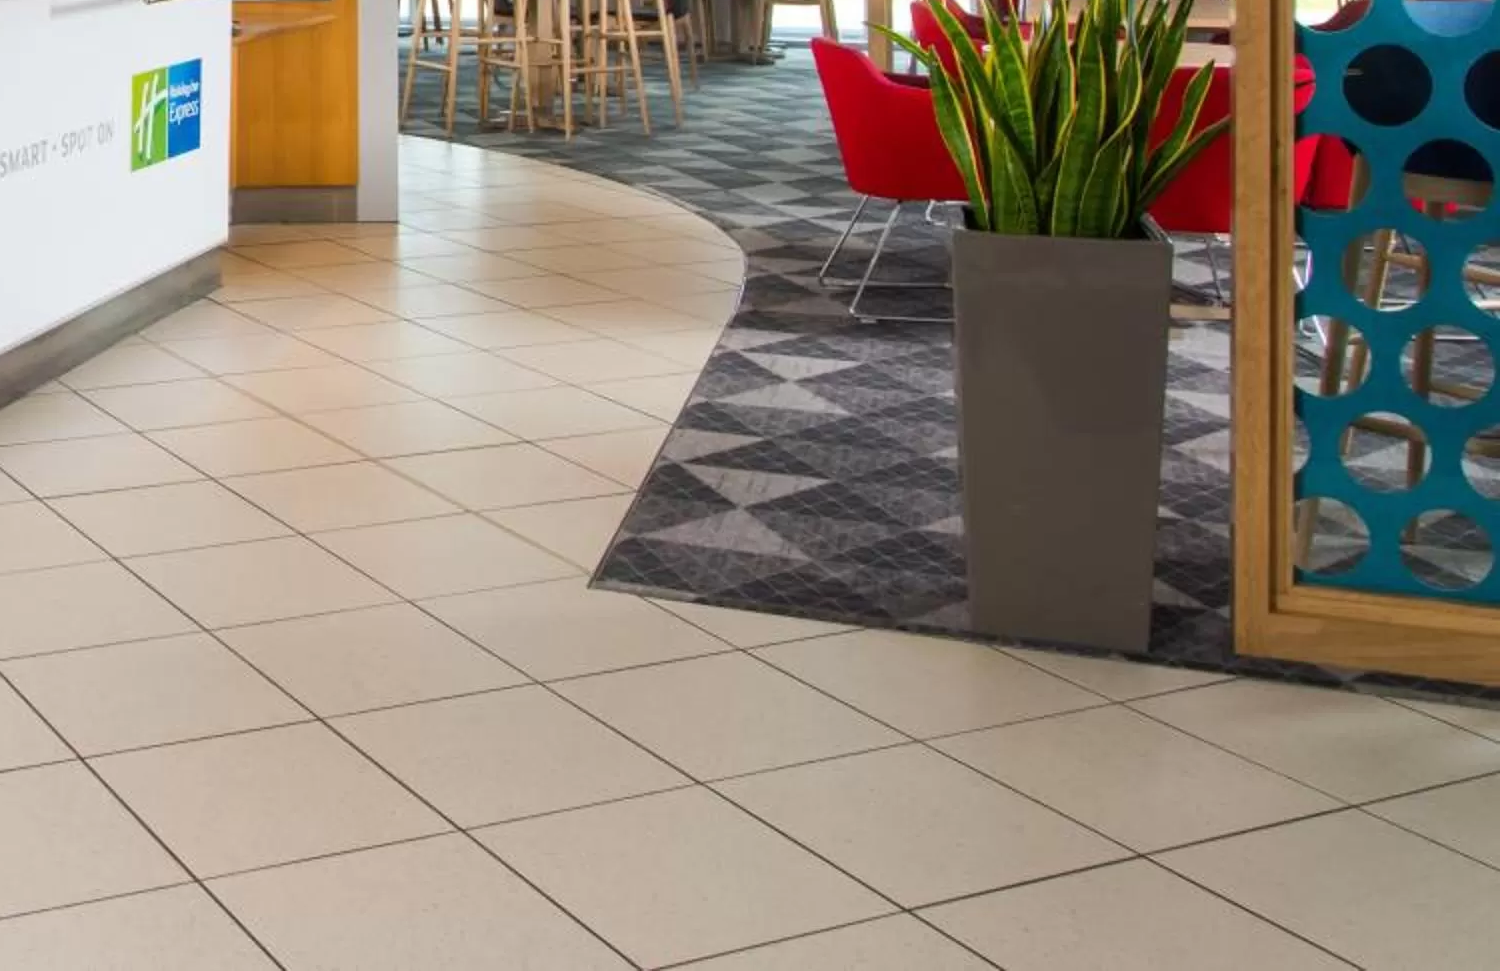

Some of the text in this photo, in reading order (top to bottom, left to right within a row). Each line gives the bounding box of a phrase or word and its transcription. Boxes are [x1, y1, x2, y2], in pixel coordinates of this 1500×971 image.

[169, 98, 199, 126] Express
[60, 124, 94, 158] SPOT
[97, 116, 115, 146] ON
